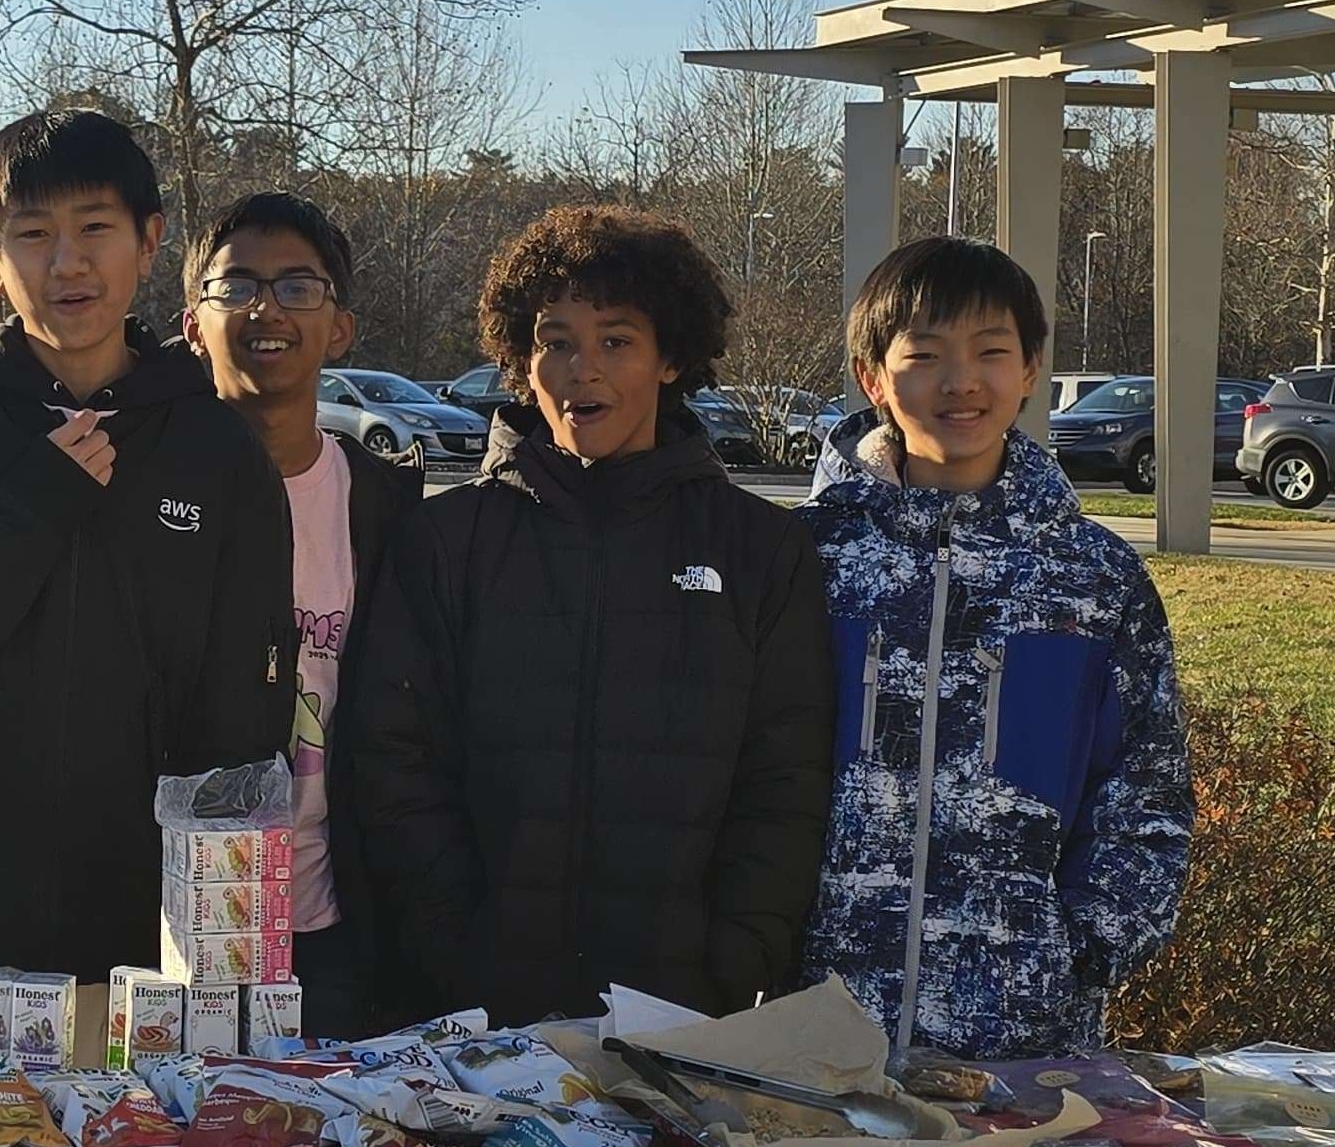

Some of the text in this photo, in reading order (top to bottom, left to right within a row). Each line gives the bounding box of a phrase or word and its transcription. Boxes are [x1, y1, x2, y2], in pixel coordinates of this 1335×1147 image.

[160, 499, 201, 521] aws
[194, 835, 205, 880] Honest
[193, 885, 204, 931] Honest
[194, 937, 205, 983] Honest
[15, 987, 61, 1001] Honest
[135, 987, 181, 998] Honest
[191, 989, 237, 1001] Honest
